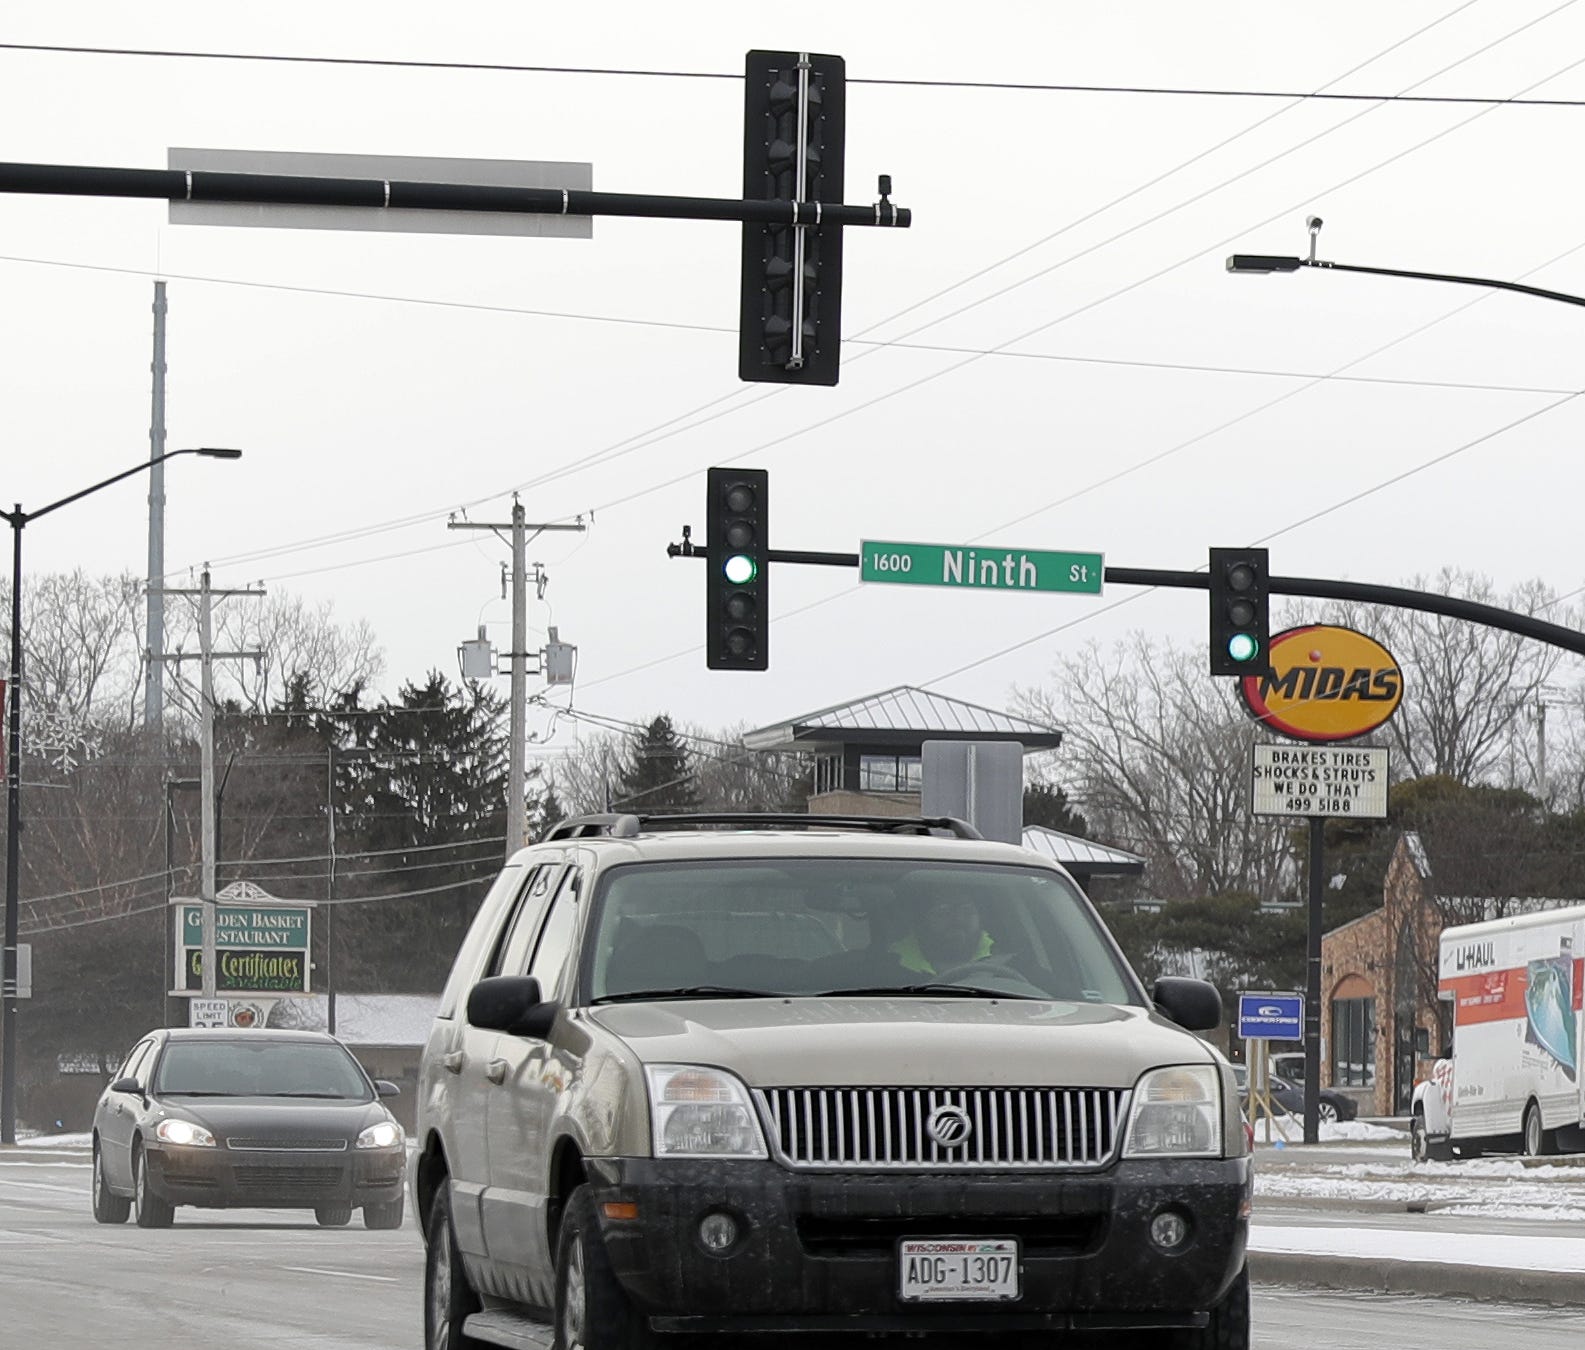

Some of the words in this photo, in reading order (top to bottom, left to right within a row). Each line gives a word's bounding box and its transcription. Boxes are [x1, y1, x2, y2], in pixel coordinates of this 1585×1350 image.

[873, 553, 912, 573] 1600
[943, 550, 1037, 587] Ninth
[1069, 564, 1088, 583] St
[1260, 667, 1399, 701] MIDAS
[1272, 752, 1326, 765] BRAKES
[1333, 753, 1370, 766] TIRES
[1323, 767, 1376, 782] STRUTS
[1273, 781, 1293, 795] WE
[1299, 782, 1317, 795] DO
[1325, 783, 1360, 797] THAT
[1286, 799, 1311, 812] 499
[1319, 799, 1351, 812] 5188
[188, 911, 248, 929] GDEN
[252, 912, 304, 929] BASKET
[216, 931, 290, 944] STAURANT
[221, 952, 299, 978] Certificates
[193, 1002, 226, 1011] SPEED
[196, 1011, 222, 1020] LIMIT
[905, 1244, 966, 1252] WISCONSIN
[908, 1256, 1013, 1284] ADG-1307
